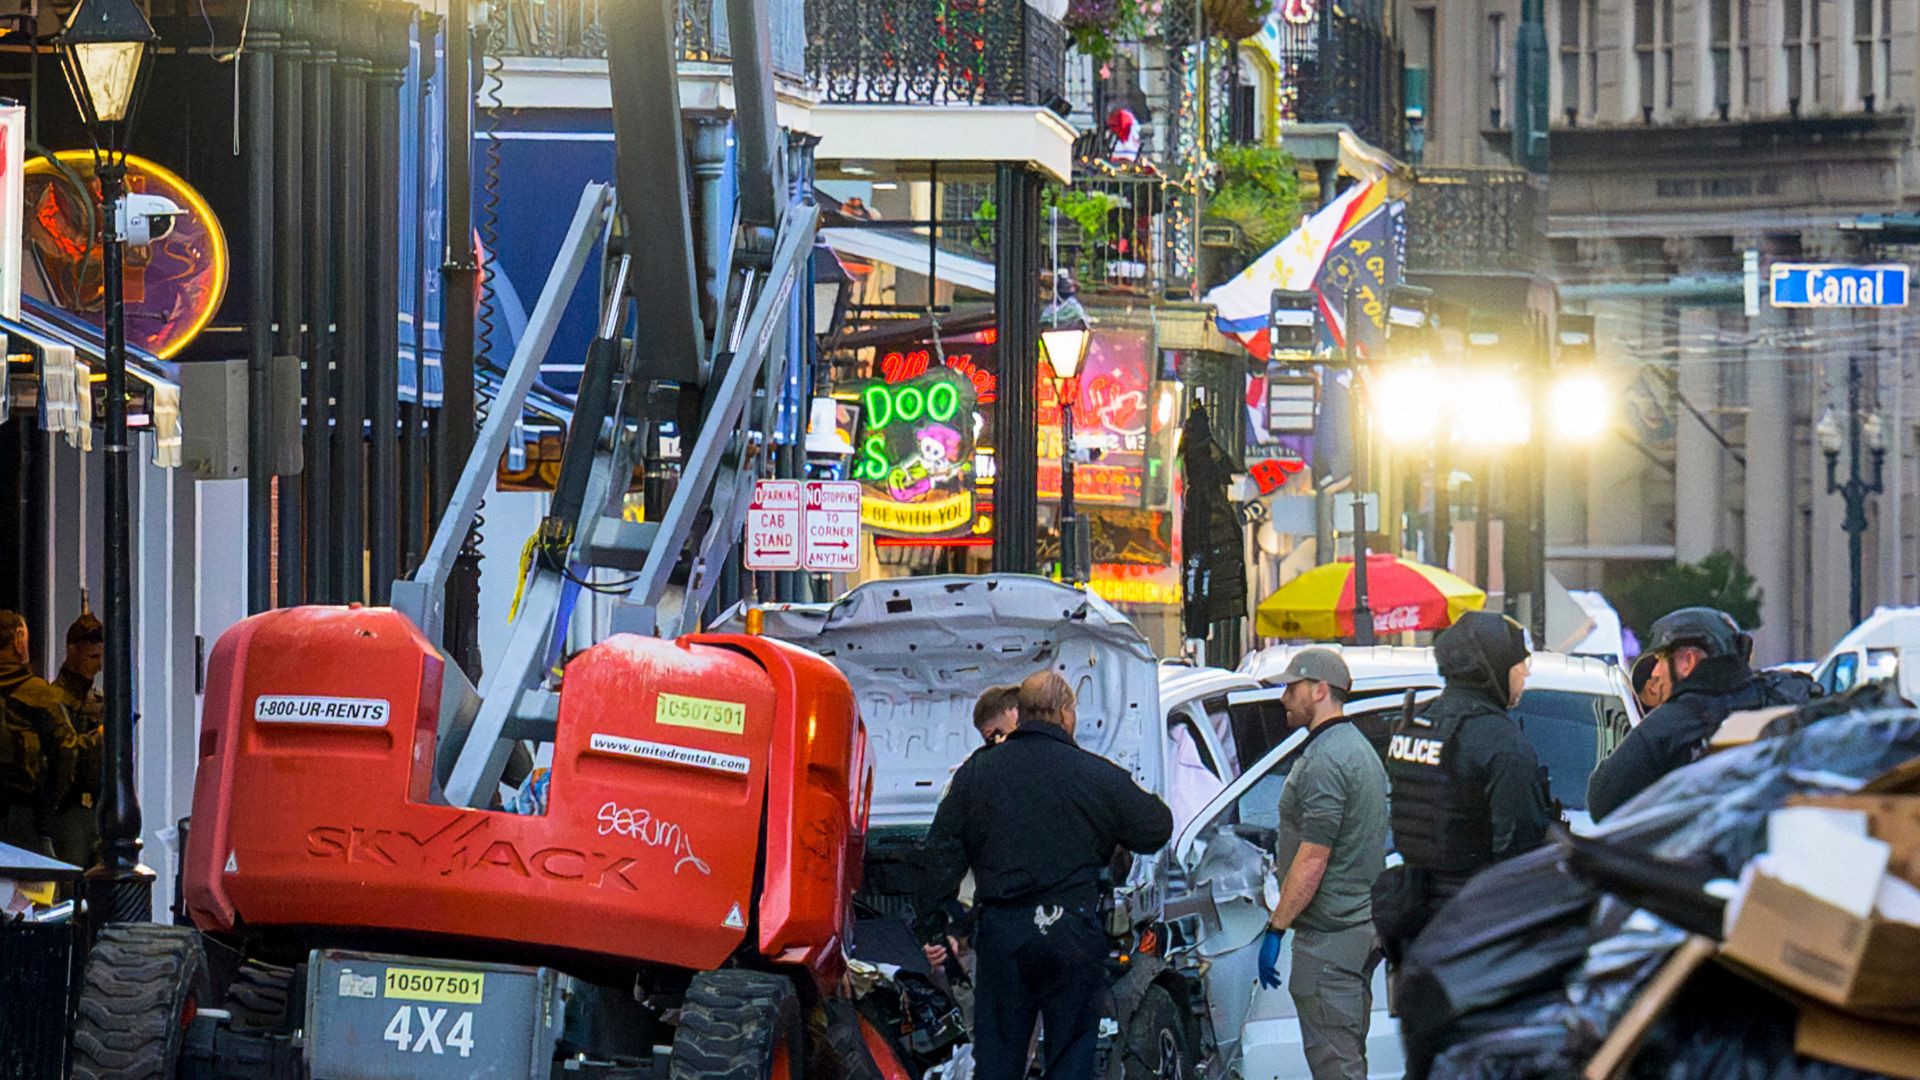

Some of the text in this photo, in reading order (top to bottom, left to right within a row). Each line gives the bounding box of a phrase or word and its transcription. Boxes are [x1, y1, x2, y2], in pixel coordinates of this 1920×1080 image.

[1806, 270, 1884, 304] Canal
[763, 490, 799, 501] PARKING
[806, 486, 859, 505] NO STOPPING
[761, 513, 785, 529] CAB
[827, 513, 840, 524] TO
[873, 506, 891, 522] BE
[896, 511, 932, 525] WITH
[754, 533, 793, 548] STAND
[810, 526, 854, 538] CORNER
[809, 552, 856, 565] ANYTIME
[259, 700, 384, 720] 1-800-UR-RENTS
[659, 695, 743, 727] 10507501
[594, 738, 746, 771] www.unitedrentals.com
[1388, 735, 1444, 766] POLICE
[307, 814, 638, 892] SKYJACK
[387, 973, 480, 995] 10507501
[383, 1005, 475, 1057] 4X4
